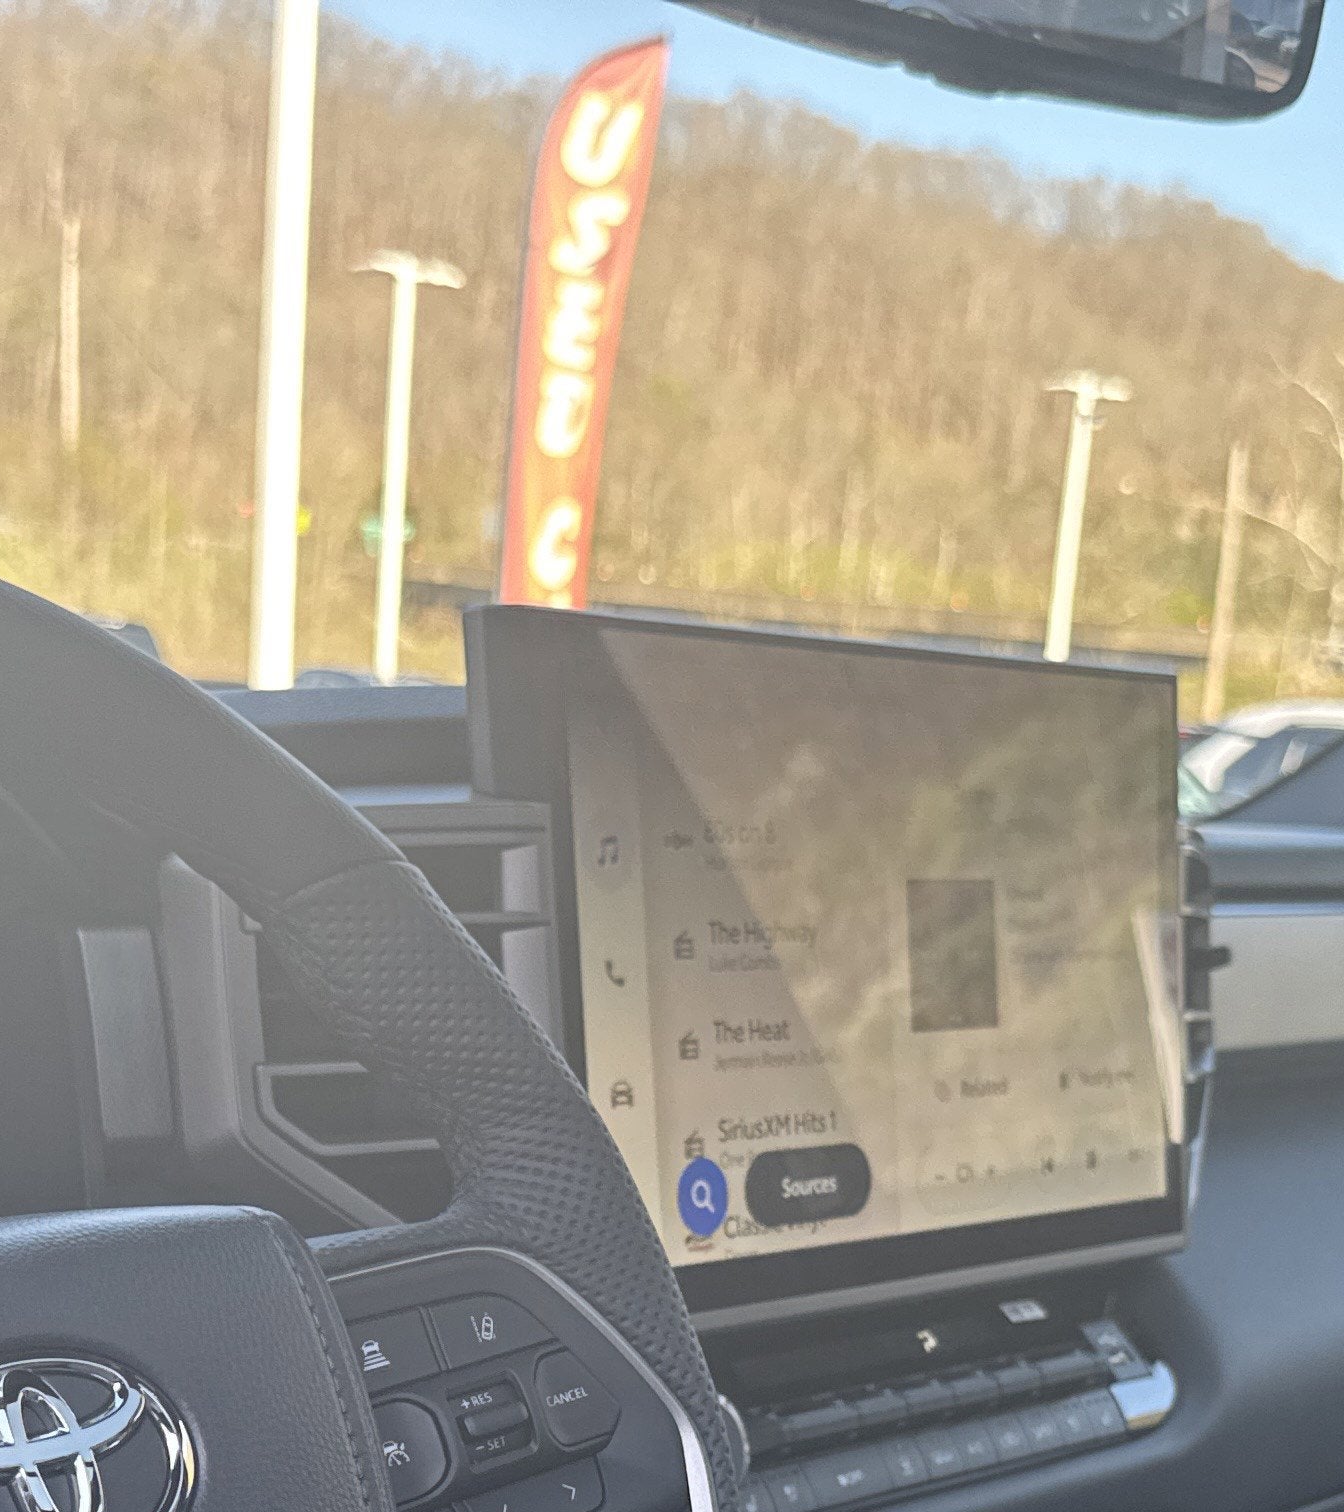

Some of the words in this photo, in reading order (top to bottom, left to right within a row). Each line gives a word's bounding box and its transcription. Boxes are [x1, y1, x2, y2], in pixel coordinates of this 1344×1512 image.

[534, 88, 644, 458] USED
[708, 919, 741, 944] The
[713, 1019, 744, 1044] The
[748, 1018, 791, 1042] Heat
[717, 1113, 791, 1143] SiriusXM
[794, 1110, 826, 1135] Hits
[780, 1177, 838, 1200] Sources
[545, 1385, 589, 1407] CANCEL
